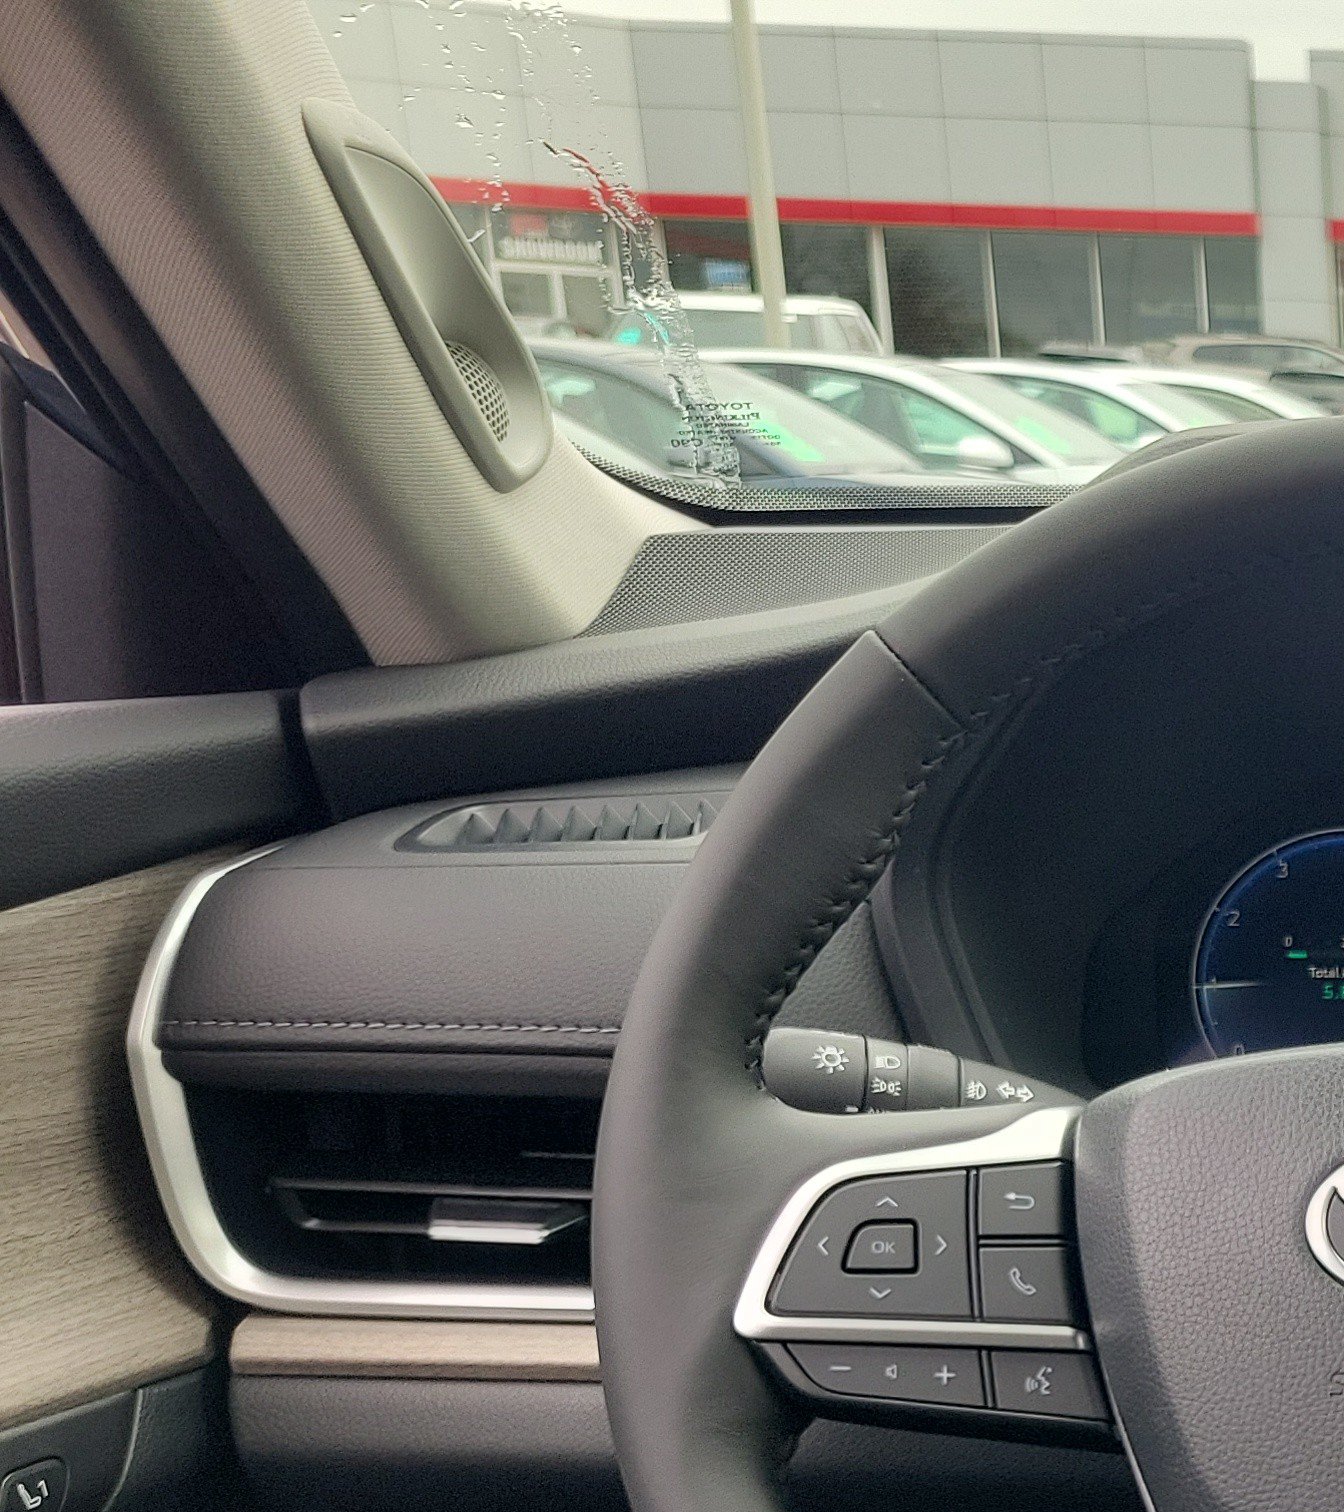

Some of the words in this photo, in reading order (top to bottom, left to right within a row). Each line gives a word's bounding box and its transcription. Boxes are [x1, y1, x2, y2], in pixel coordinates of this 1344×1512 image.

[1276, 861, 1289, 879] 3
[1226, 910, 1241, 928] 2
[1284, 934, 1294, 948] 0
[1308, 966, 1340, 979] Total
[871, 1240, 896, 1254] OK
